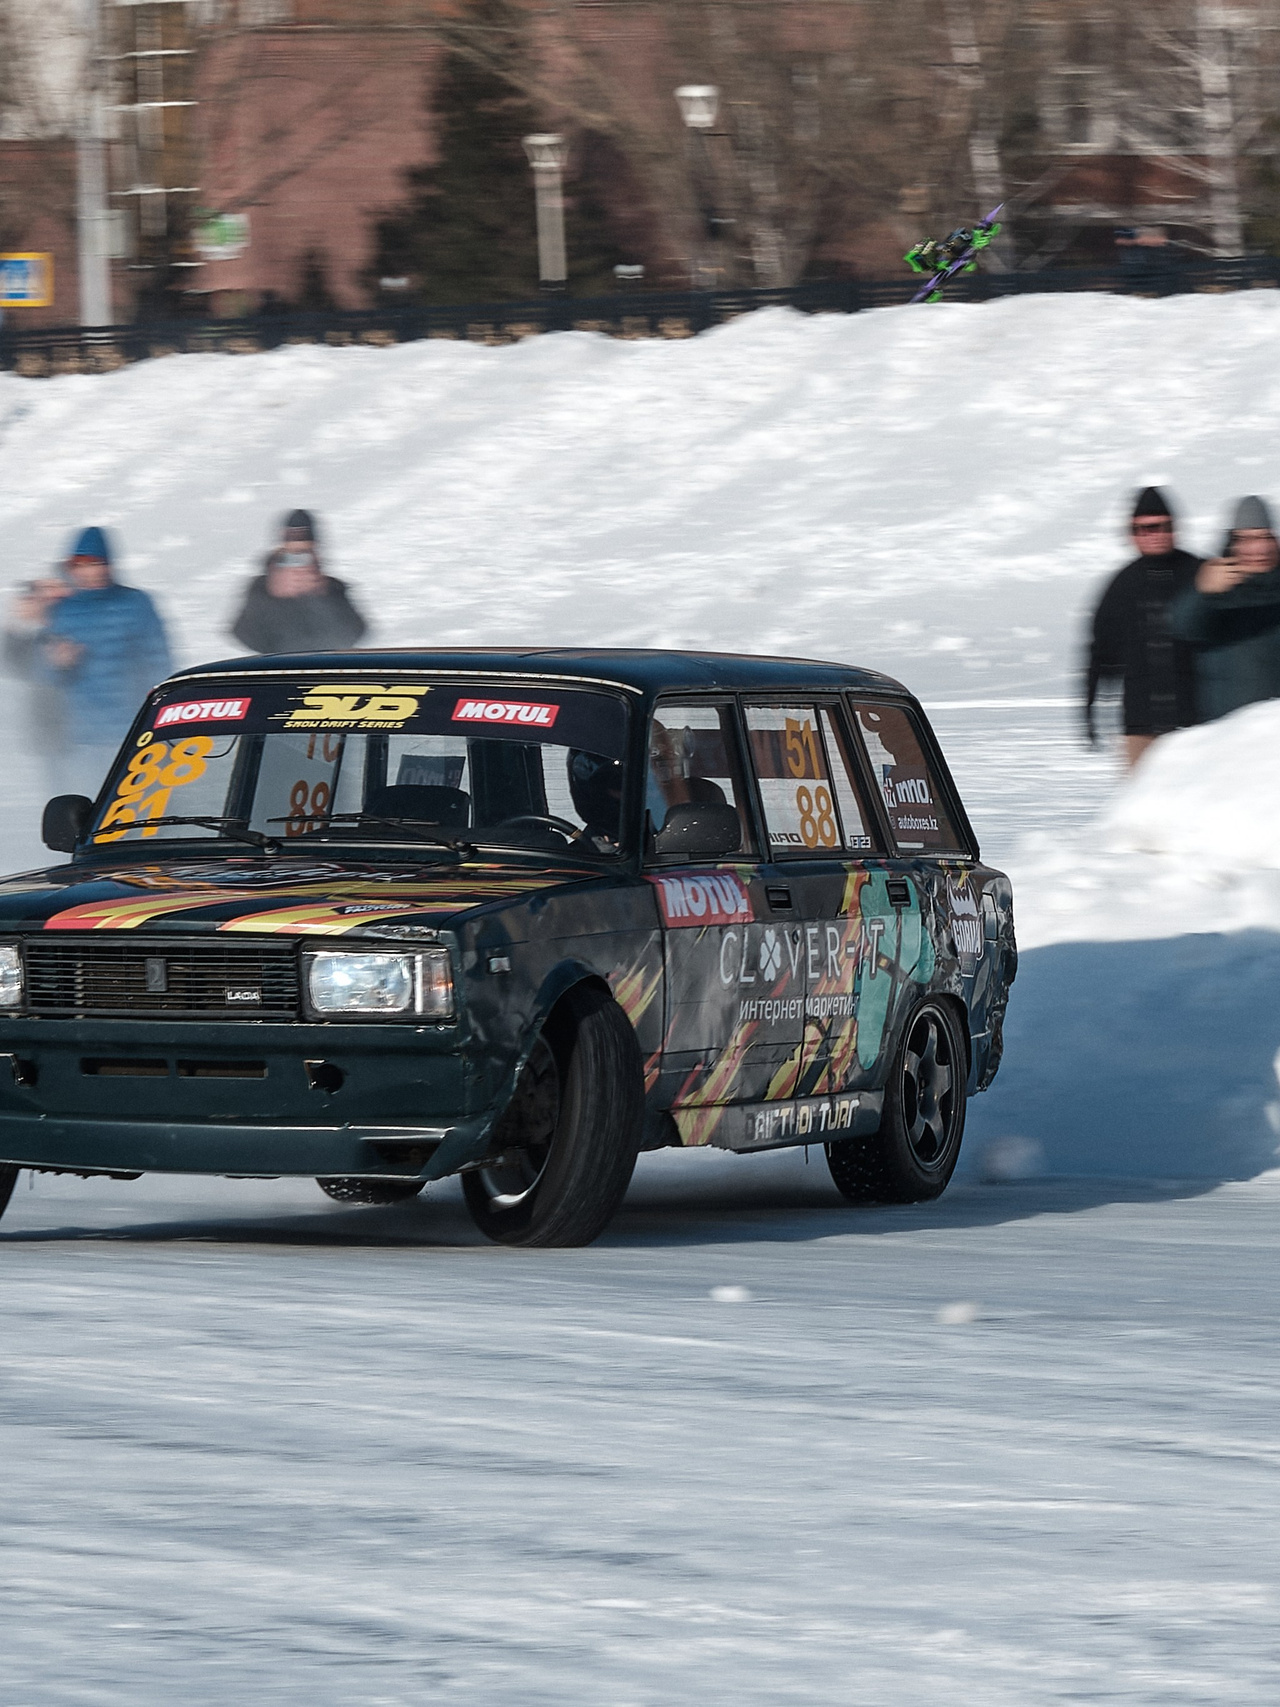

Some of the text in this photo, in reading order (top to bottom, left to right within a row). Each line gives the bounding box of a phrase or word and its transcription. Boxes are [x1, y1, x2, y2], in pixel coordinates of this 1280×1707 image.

[157, 701, 243, 725] MOTUL
[282, 721, 320, 729] SNOW
[357, 721, 406, 729] SERIES
[456, 702, 551, 724] MOTUL
[117, 736, 214, 796] 88
[785, 717, 821, 780] 51
[93, 787, 173, 844] 51
[796, 785, 837, 848] 88
[659, 875, 749, 918] MOTUL
[739, 995, 859, 1026] интернет маркетин
